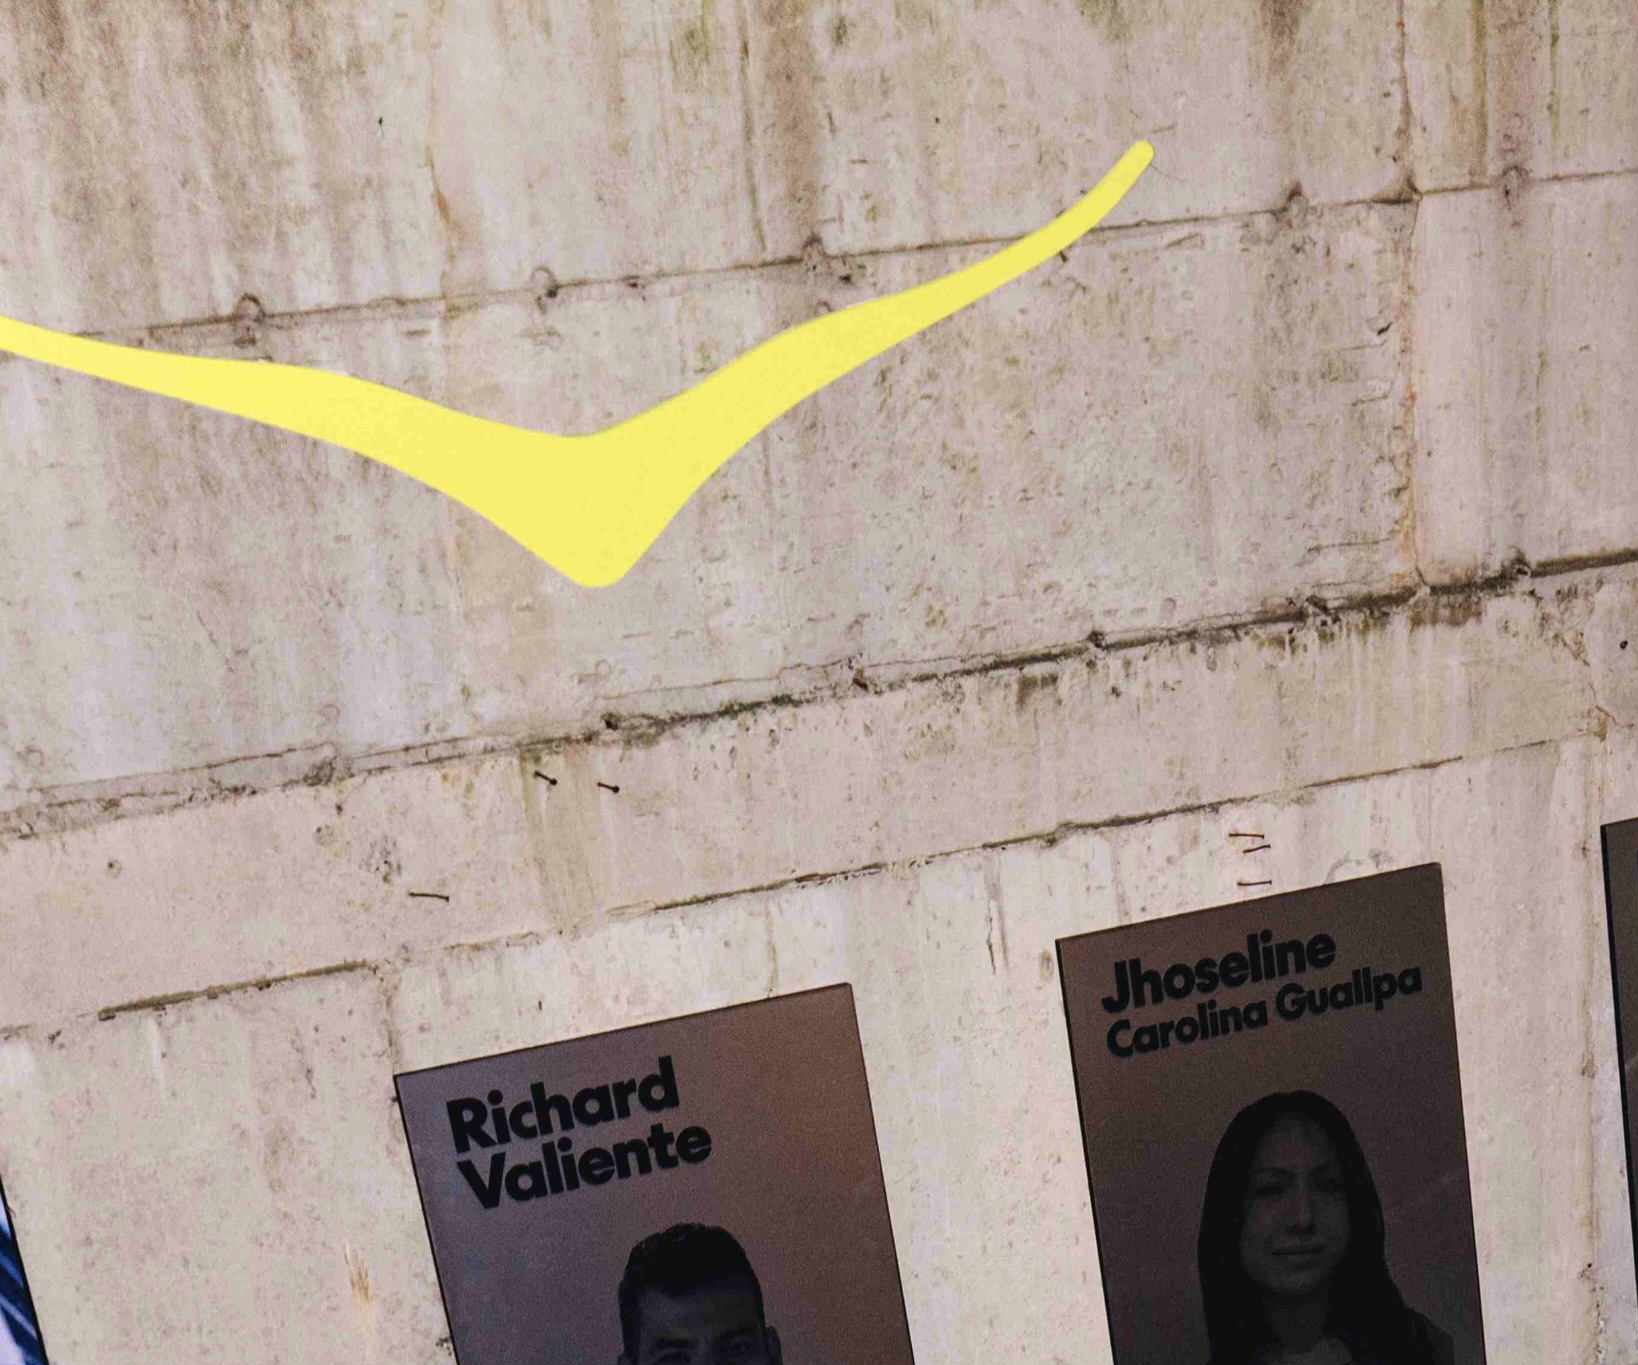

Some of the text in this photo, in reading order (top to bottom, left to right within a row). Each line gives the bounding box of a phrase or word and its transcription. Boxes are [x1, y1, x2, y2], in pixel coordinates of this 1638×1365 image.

[1102, 929, 1337, 1014] Jhoseline
[1107, 967, 1423, 1058] Carolina Guallpa
[446, 1055, 680, 1154] Richard
[456, 1123, 712, 1210] Valiente
